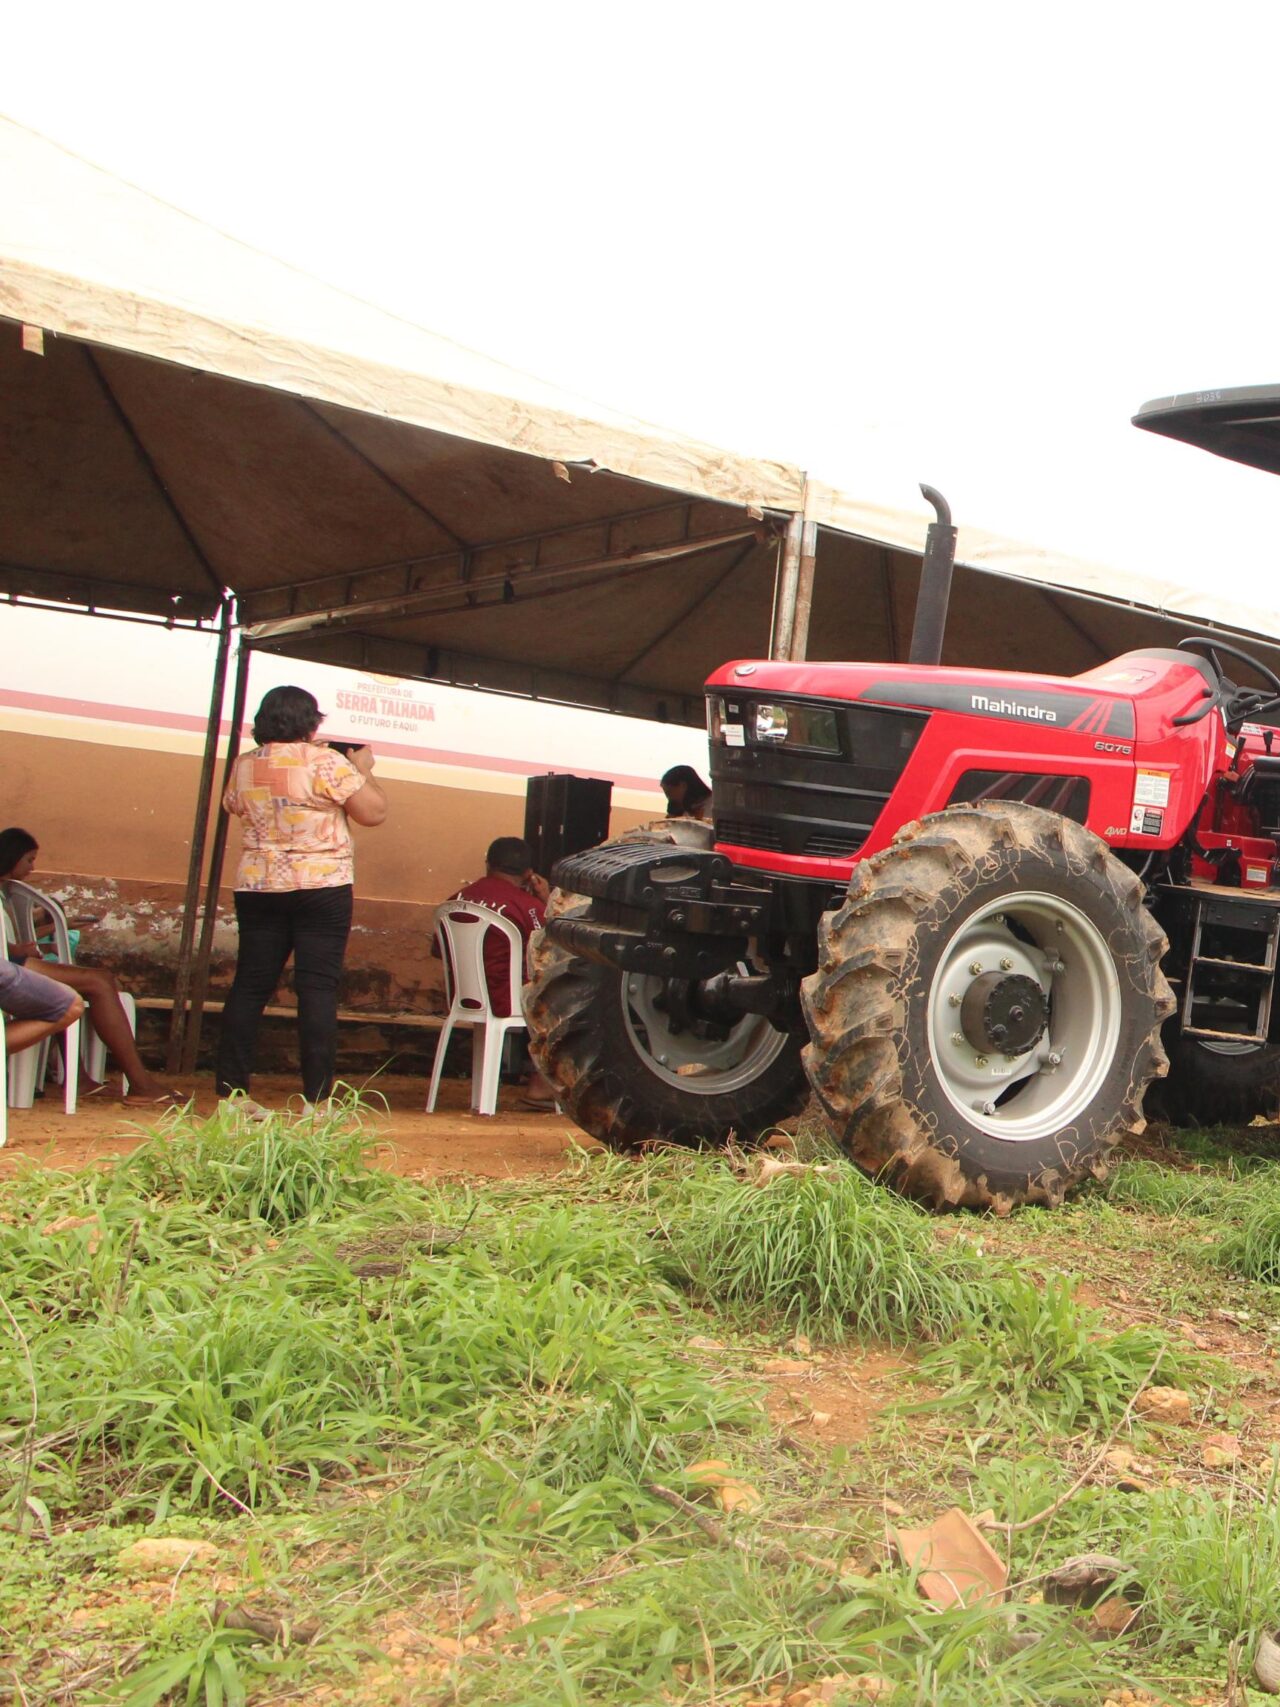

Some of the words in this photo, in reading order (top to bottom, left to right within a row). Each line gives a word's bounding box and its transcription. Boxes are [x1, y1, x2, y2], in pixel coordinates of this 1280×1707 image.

[357, 682, 401, 697] PREFEITURA
[403, 689, 414, 698] DE
[336, 691, 378, 714] SERRA
[380, 698, 436, 722] TALHADA
[358, 715, 391, 728] FUTURO
[1094, 741, 1132, 755] 6075
[1104, 826, 1128, 838] 4WD
